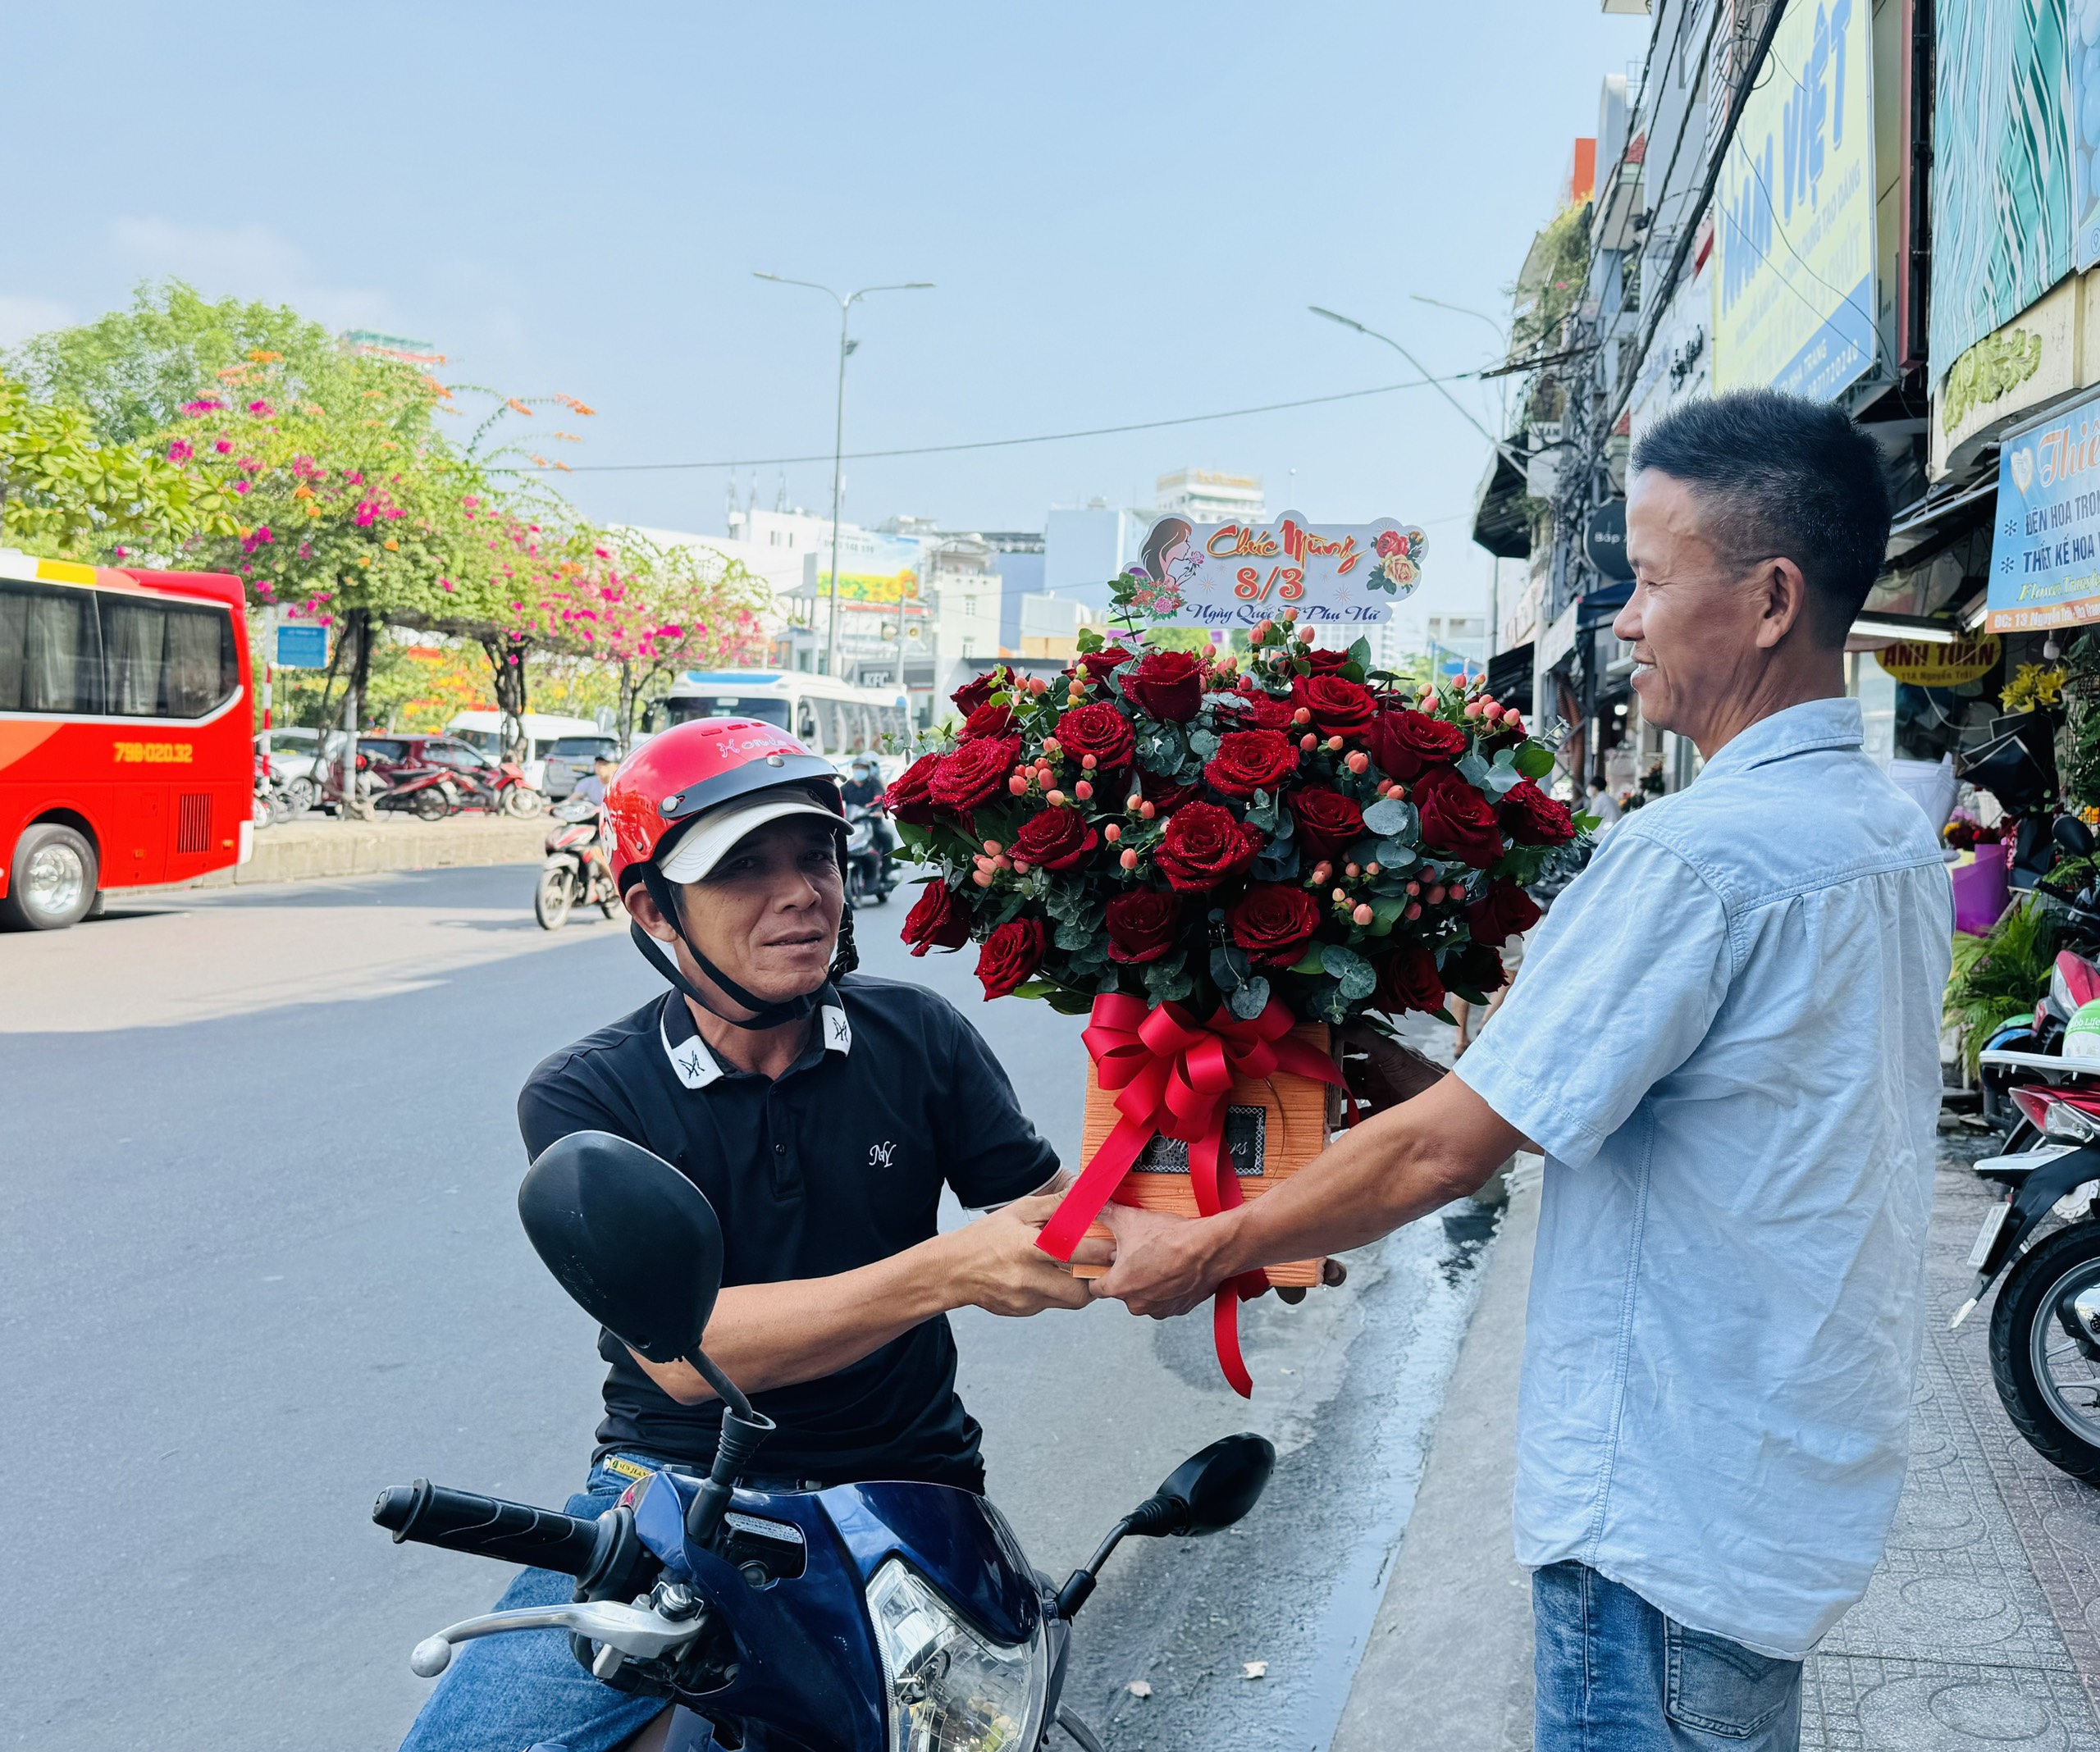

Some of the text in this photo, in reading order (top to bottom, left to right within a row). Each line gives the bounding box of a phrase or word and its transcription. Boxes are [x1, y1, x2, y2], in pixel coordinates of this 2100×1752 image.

[1783, 0, 1853, 226] VIỆT
[2051, 500, 2072, 529] HOA
[1206, 519, 1367, 574] Chúc Mừng
[2056, 533, 2070, 567] KẾ
[2072, 534, 2095, 563] HOA
[1234, 565, 1304, 602] 8/3
[1186, 604, 1233, 624] Ngày
[1303, 605, 1340, 623] Phụ
[1345, 605, 1381, 622] Nữ
[2015, 612, 2028, 627] 13
[863, 672, 890, 687] KFC
